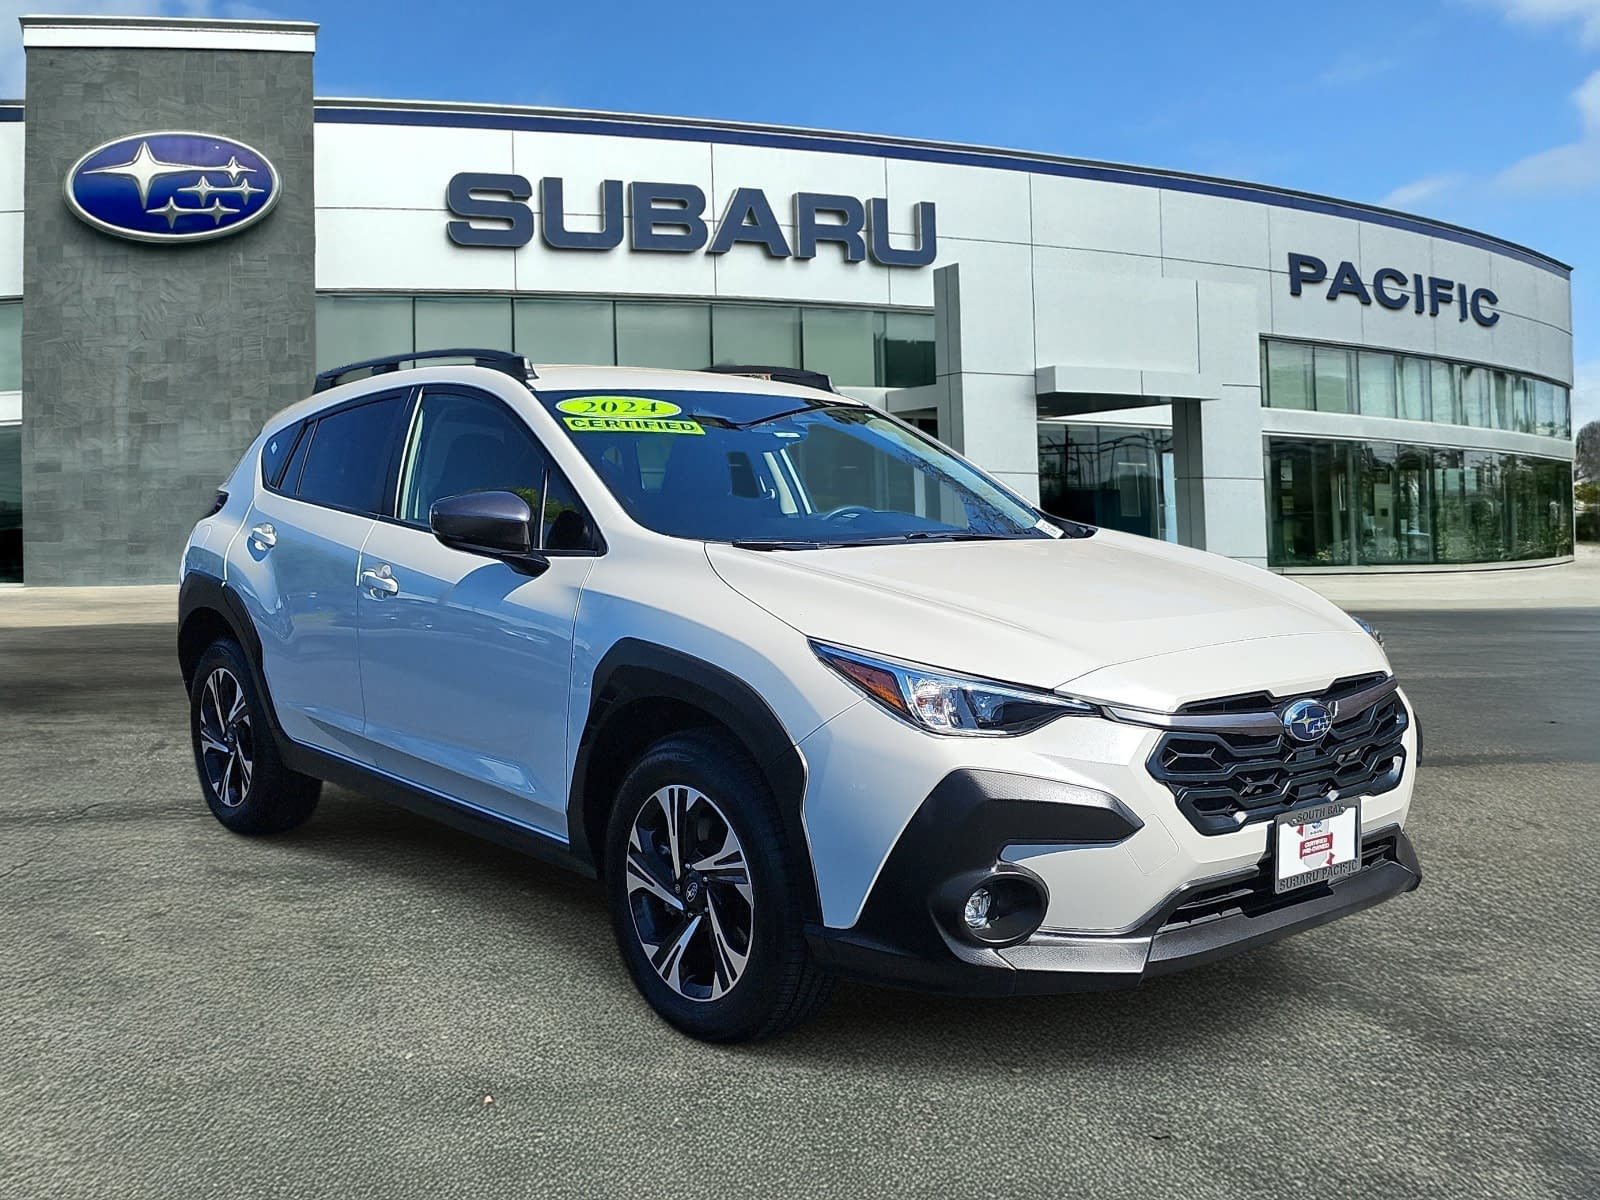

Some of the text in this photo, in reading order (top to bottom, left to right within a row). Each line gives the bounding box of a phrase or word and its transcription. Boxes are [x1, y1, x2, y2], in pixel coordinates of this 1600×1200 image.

[446, 171, 937, 267] SUBARU
[1287, 251, 1500, 328] PACIFIC
[582, 401, 659, 414] 2024
[570, 418, 695, 432] CERTIFIED
[1297, 802, 1344, 822] SOUTH BAY
[1279, 860, 1357, 891] SUBARU PACIFIC
